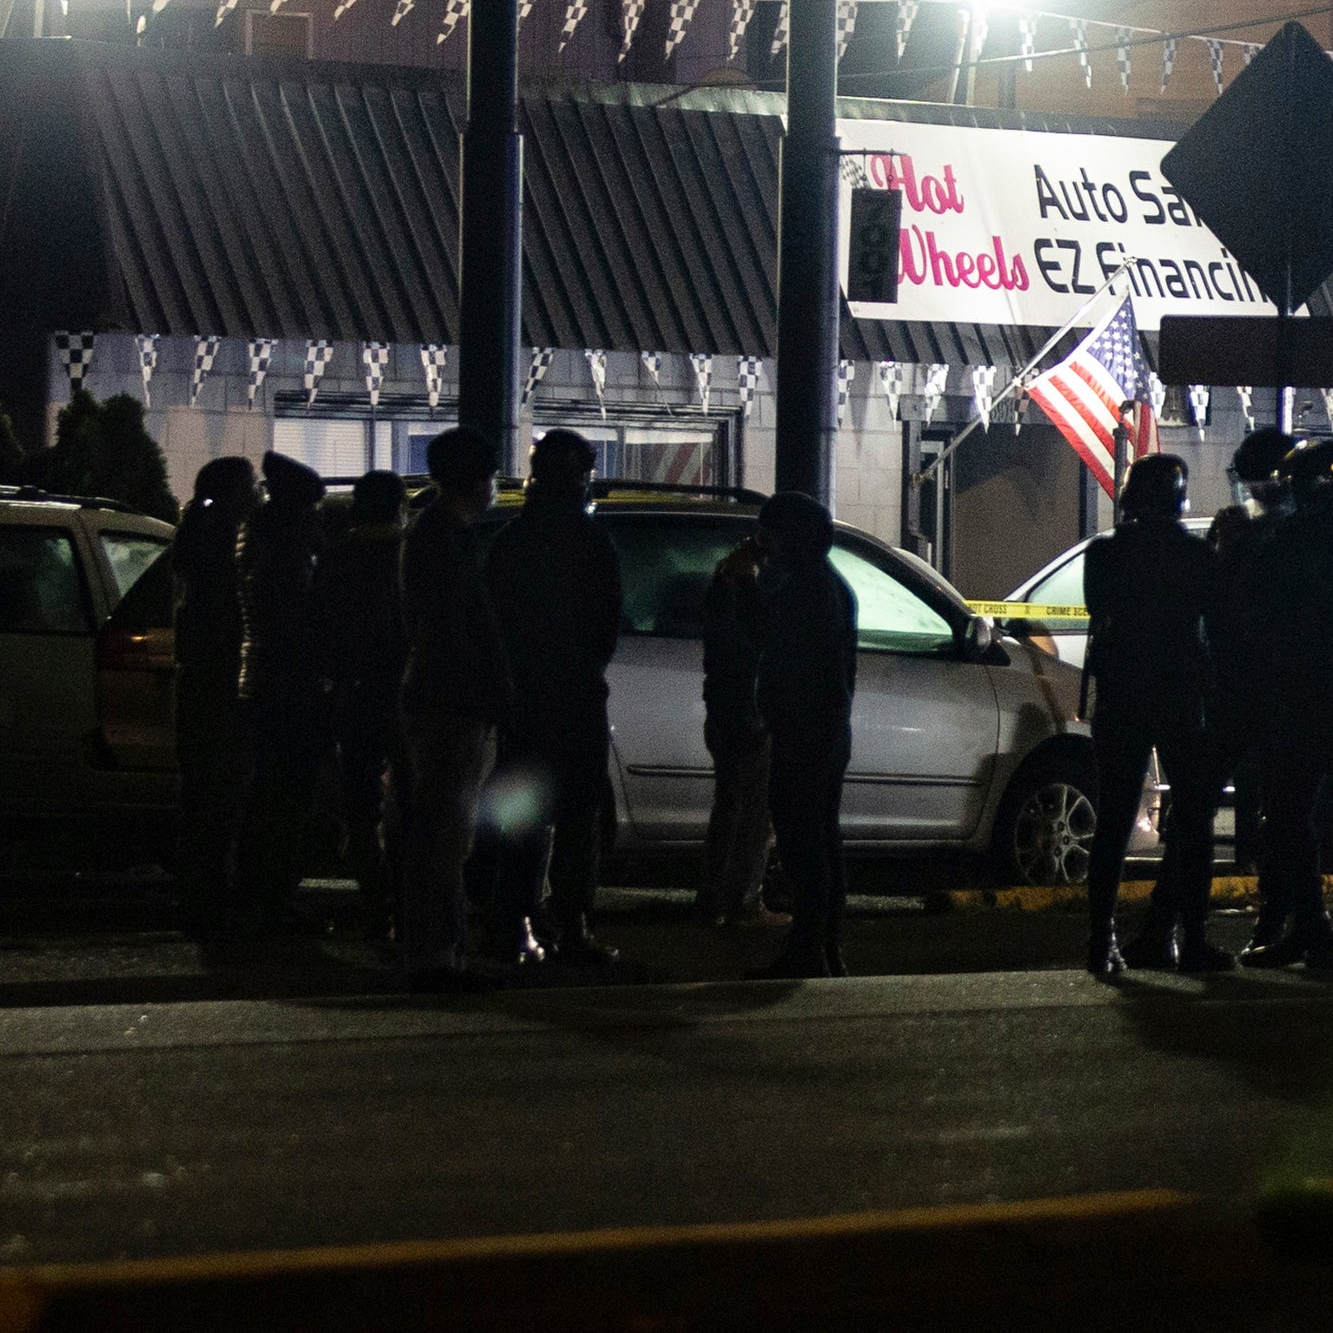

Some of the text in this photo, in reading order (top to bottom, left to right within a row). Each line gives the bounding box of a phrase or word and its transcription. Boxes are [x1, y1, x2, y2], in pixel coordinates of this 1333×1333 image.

[870, 154, 965, 215] Hot
[1034, 164, 1203, 227] Auto Sa
[1034, 238, 1096, 295] EZ
[983, 604, 1008, 615] CROSS
[1046, 606, 1071, 616] CRIME
[1073, 607, 1088, 617] SCE
